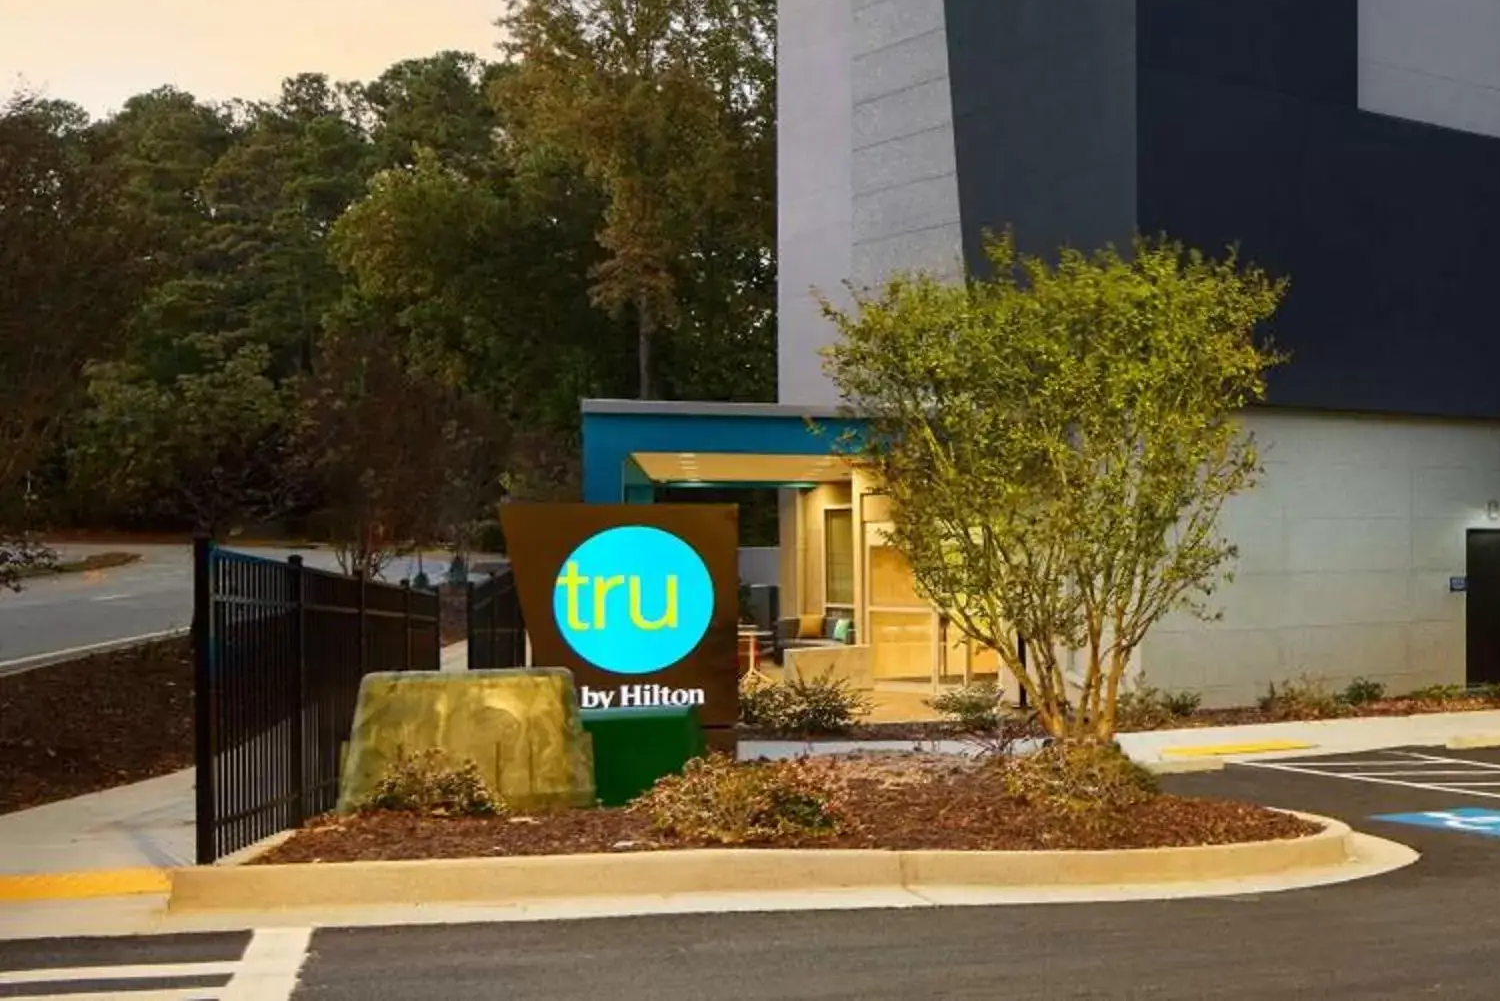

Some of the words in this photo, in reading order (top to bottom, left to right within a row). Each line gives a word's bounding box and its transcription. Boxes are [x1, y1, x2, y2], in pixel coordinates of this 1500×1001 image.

[556, 561, 679, 631] tru
[580, 685, 615, 709] by
[620, 683, 705, 707] Hilton
